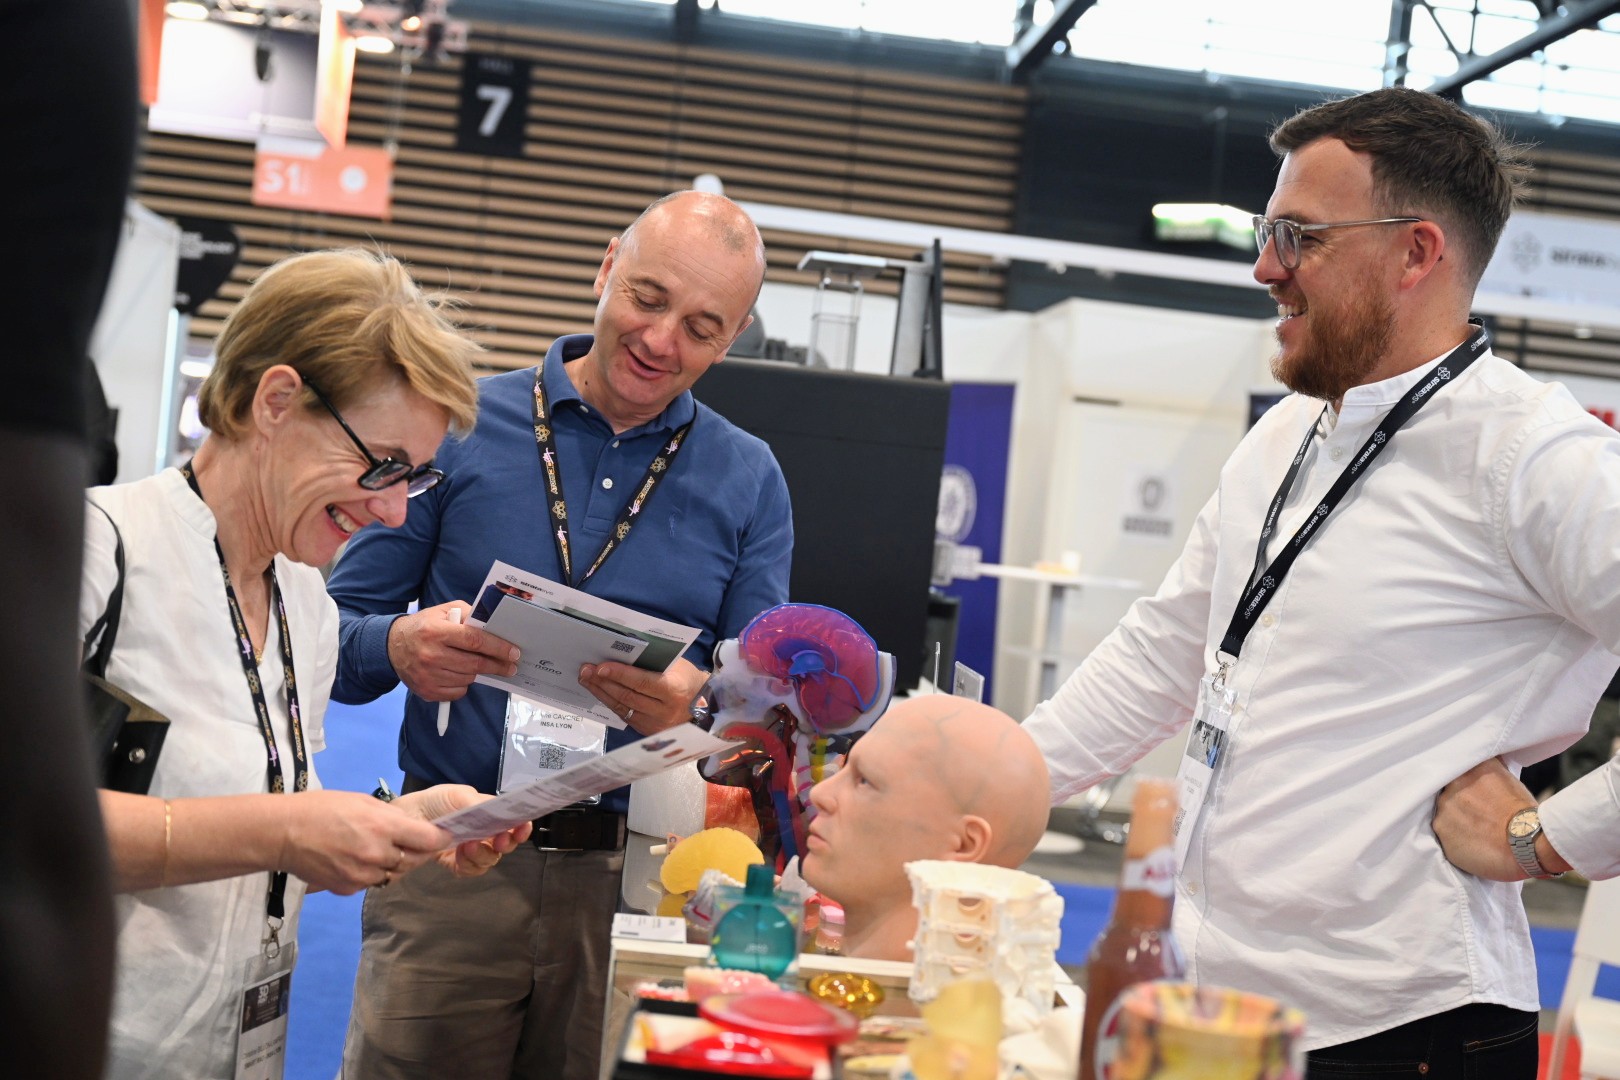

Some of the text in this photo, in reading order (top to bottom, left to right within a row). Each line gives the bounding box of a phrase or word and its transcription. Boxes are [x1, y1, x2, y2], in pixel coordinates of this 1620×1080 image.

[476, 84, 513, 137] 7
[1412, 376, 1440, 403] stratasys
[1352, 442, 1377, 474] stratasys
[1295, 515, 1319, 546] stratasys
[1245, 587, 1266, 619] stratasys
[555, 722, 573, 730] LYON
